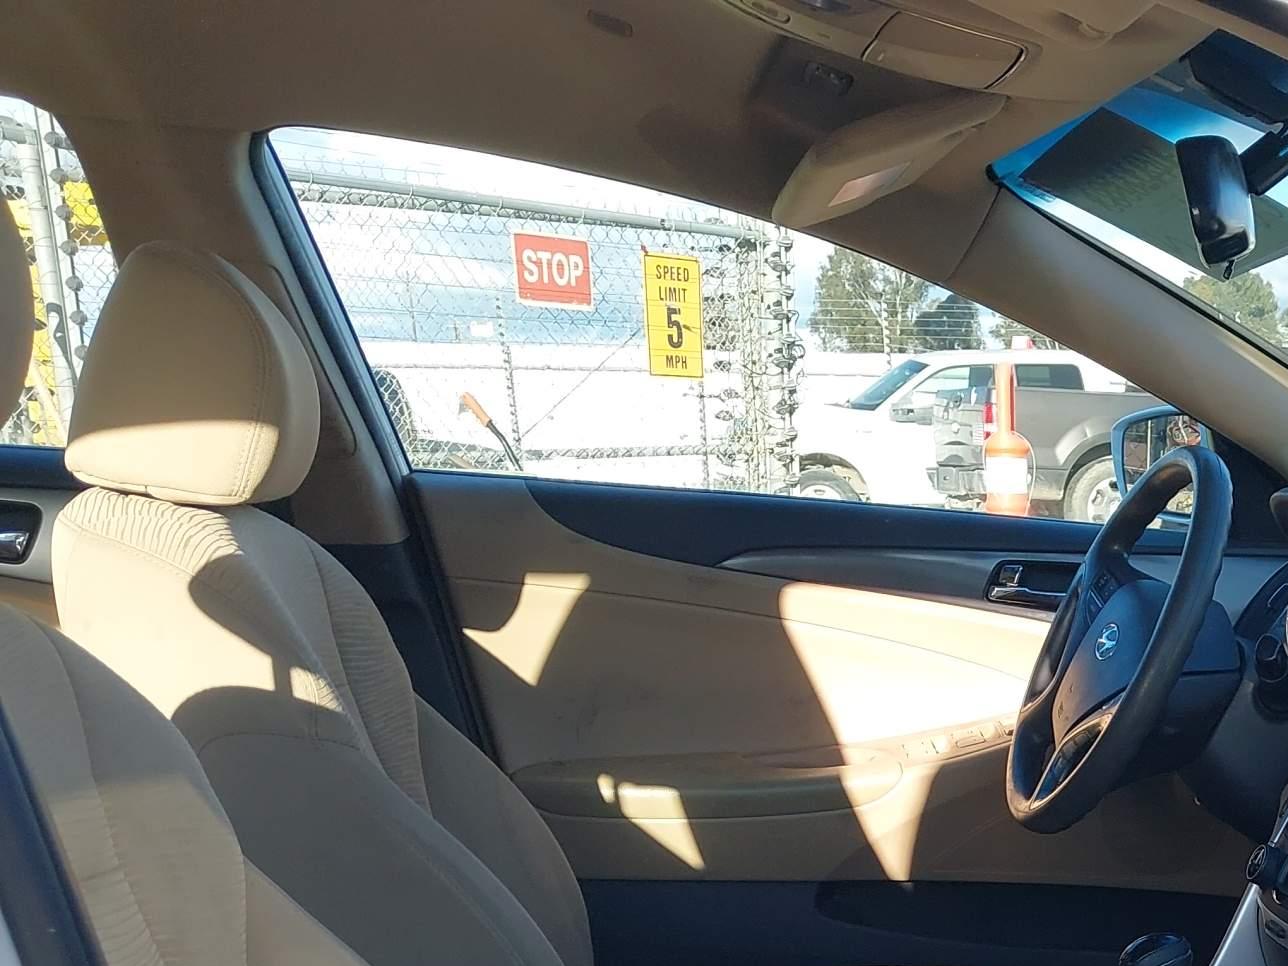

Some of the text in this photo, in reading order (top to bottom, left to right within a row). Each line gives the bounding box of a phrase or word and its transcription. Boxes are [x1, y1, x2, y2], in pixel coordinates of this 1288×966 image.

[522, 248, 585, 287] STOP
[655, 264, 690, 282] SPEED
[658, 286, 687, 303] LIMIT
[666, 307, 683, 349] 5
[665, 354, 688, 370] MPH
